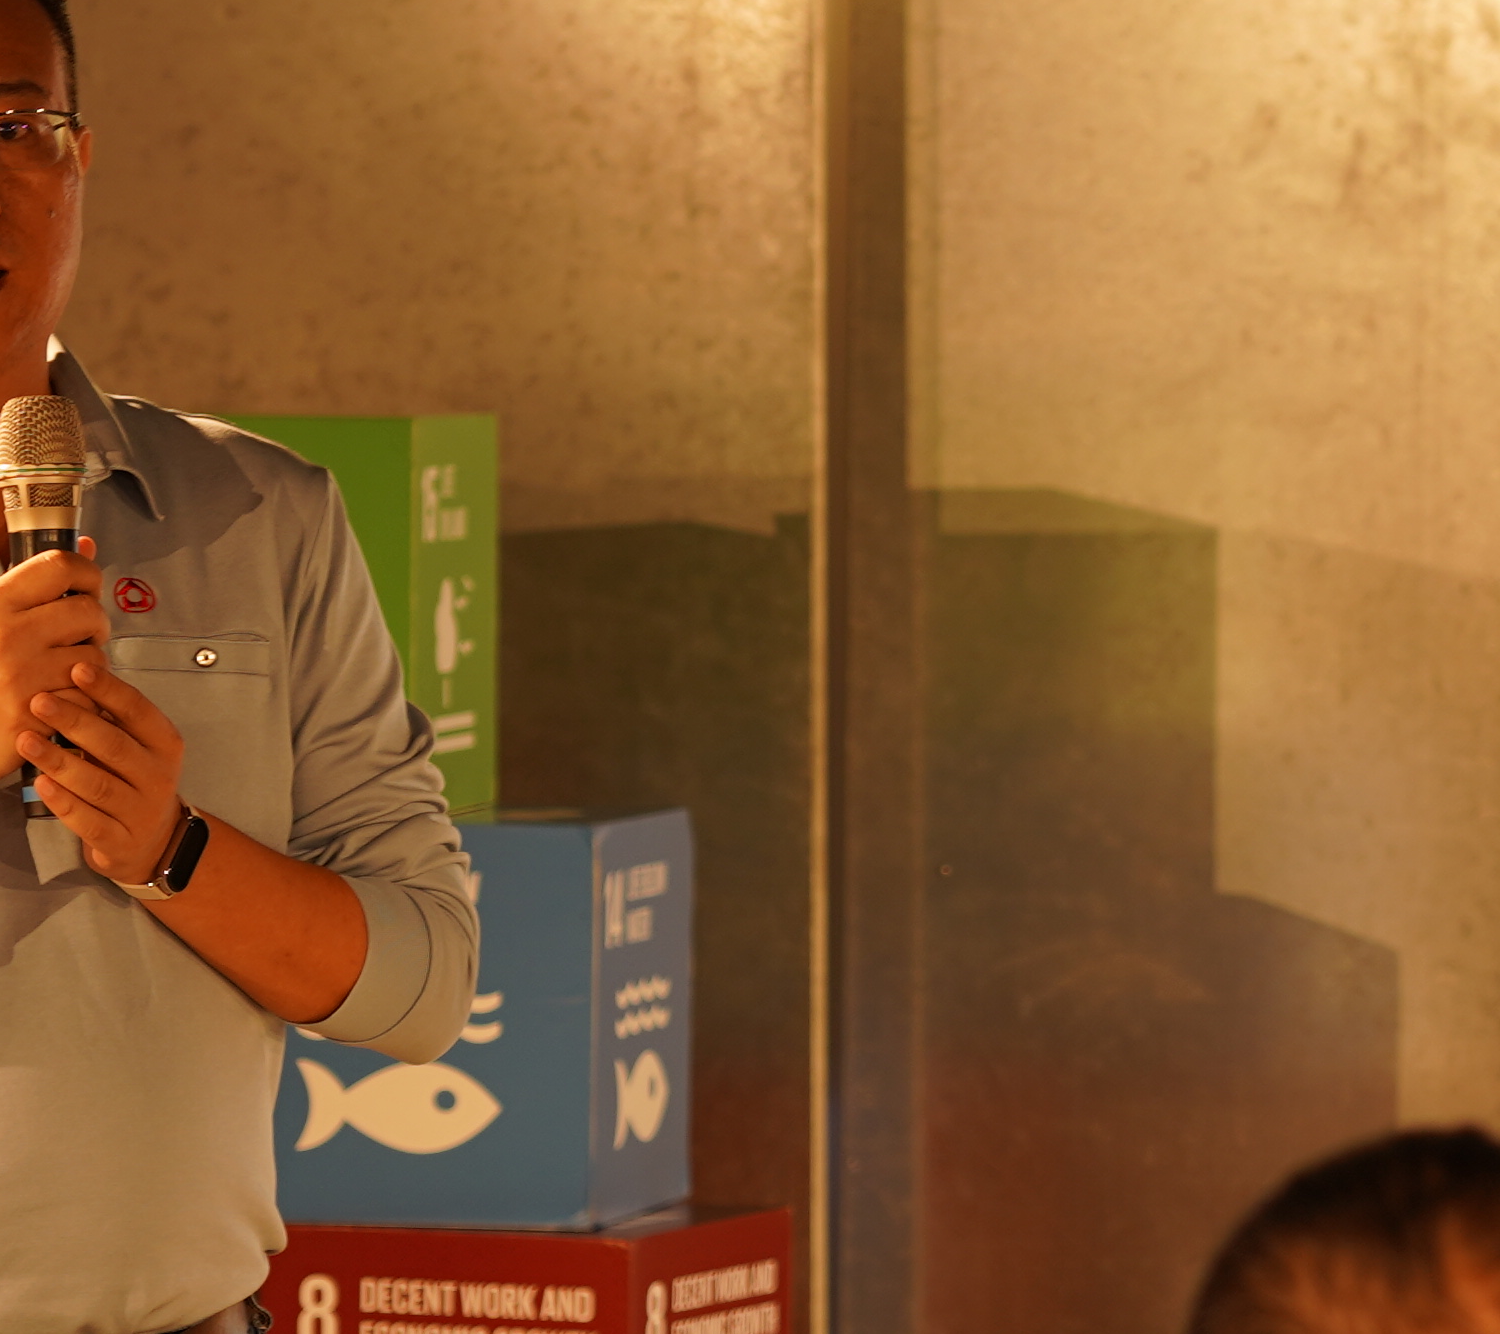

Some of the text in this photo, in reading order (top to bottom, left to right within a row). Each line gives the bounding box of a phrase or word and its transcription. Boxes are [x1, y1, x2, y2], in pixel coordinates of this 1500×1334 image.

[359, 1276, 596, 1323] DECENT WORK AND
